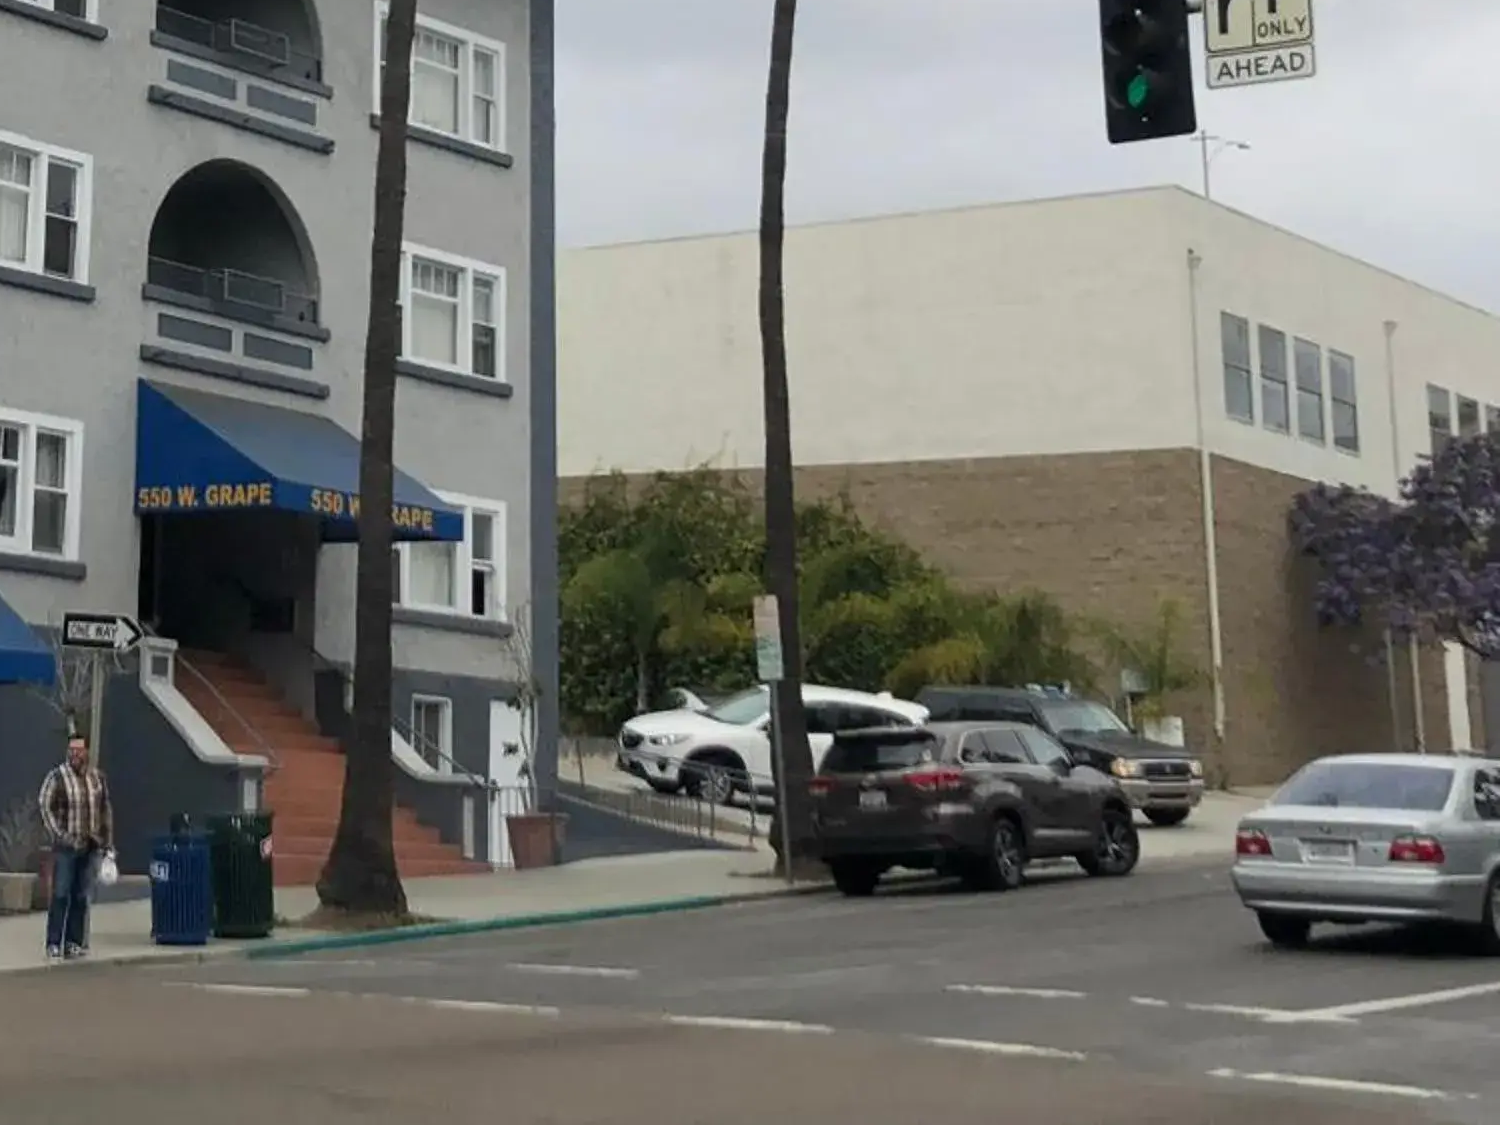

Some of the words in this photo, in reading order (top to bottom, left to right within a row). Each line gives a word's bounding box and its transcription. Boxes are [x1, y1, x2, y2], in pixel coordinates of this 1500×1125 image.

[1257, 15, 1306, 38] ONLY
[1216, 52, 1305, 81] AHEAD
[138, 486, 171, 508] 550
[177, 486, 197, 507] W.
[205, 483, 272, 507] GRAPE
[311, 488, 343, 515] 550
[348, 494, 360, 518] W
[392, 505, 433, 531] RAPE
[70, 623, 90, 638] ONE
[95, 623, 118, 640] WAY
